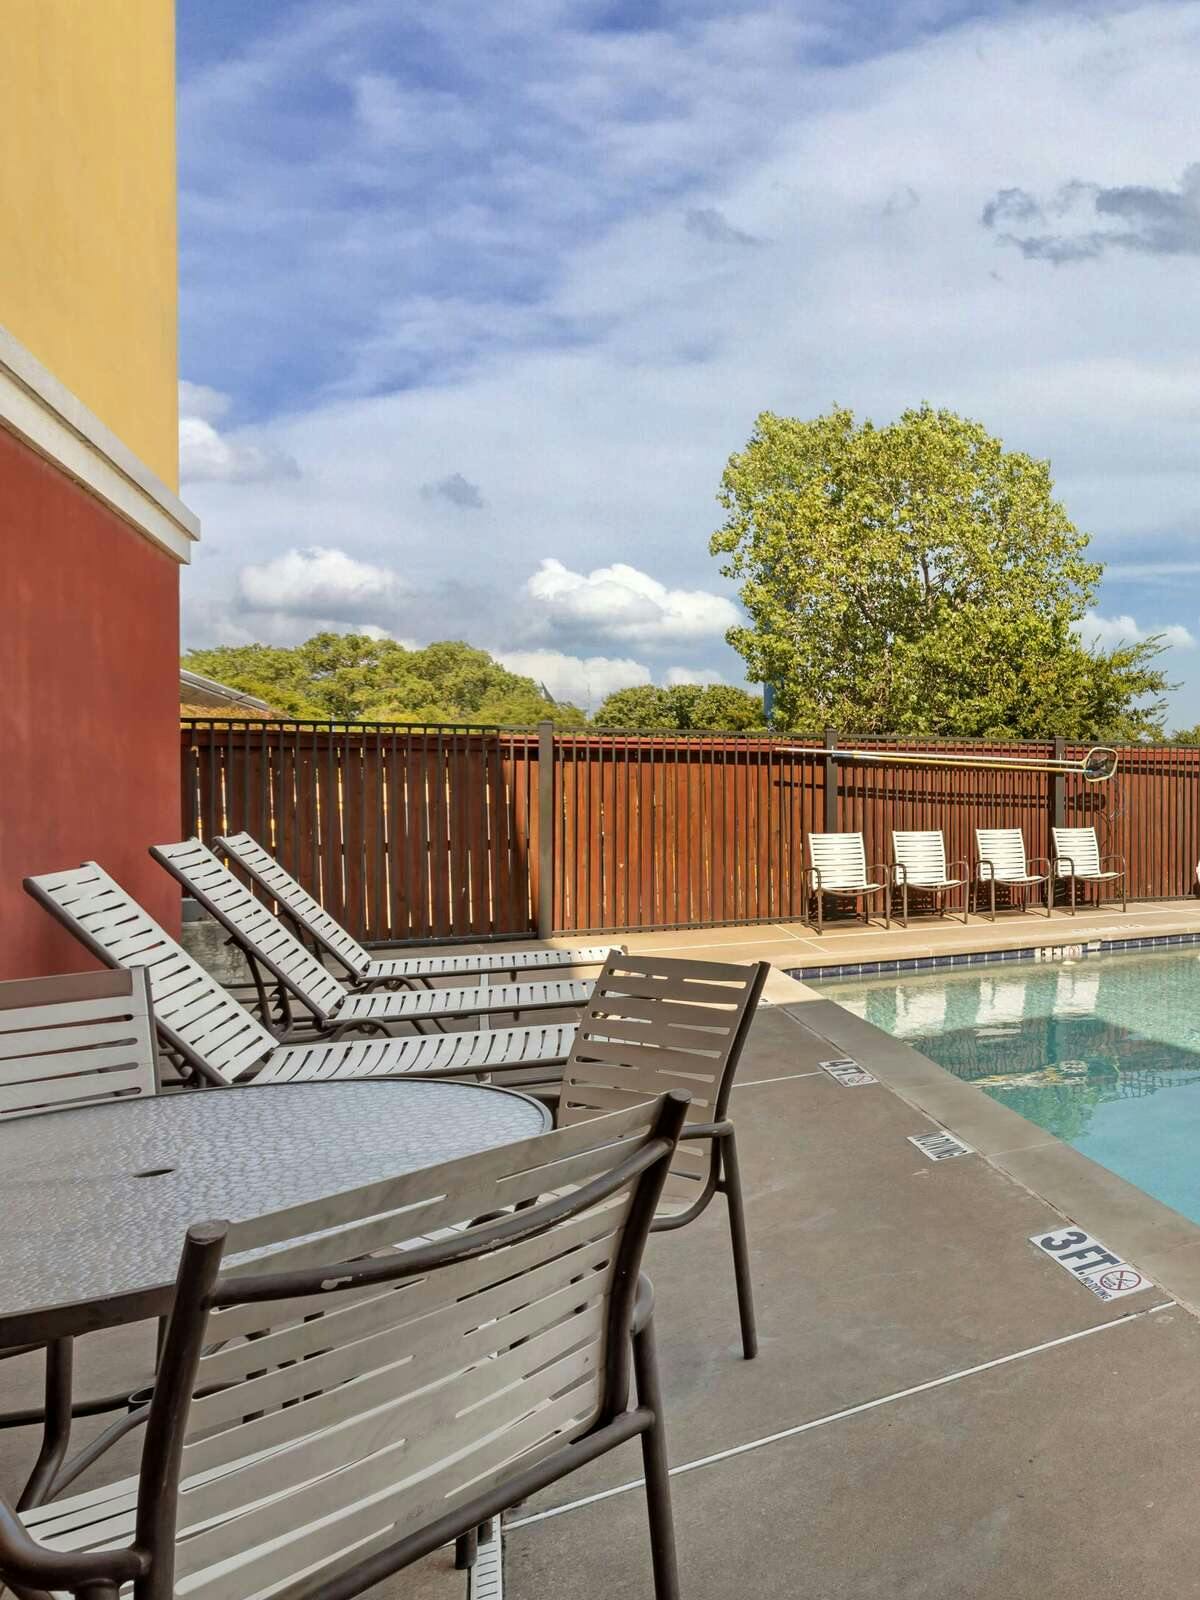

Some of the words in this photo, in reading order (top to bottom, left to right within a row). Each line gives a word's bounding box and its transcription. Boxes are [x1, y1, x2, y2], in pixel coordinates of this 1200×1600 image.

[825, 1060, 854, 1068] 4
[1040, 1231, 1088, 1251] 3
[1089, 1283, 1113, 1300] DIVING
